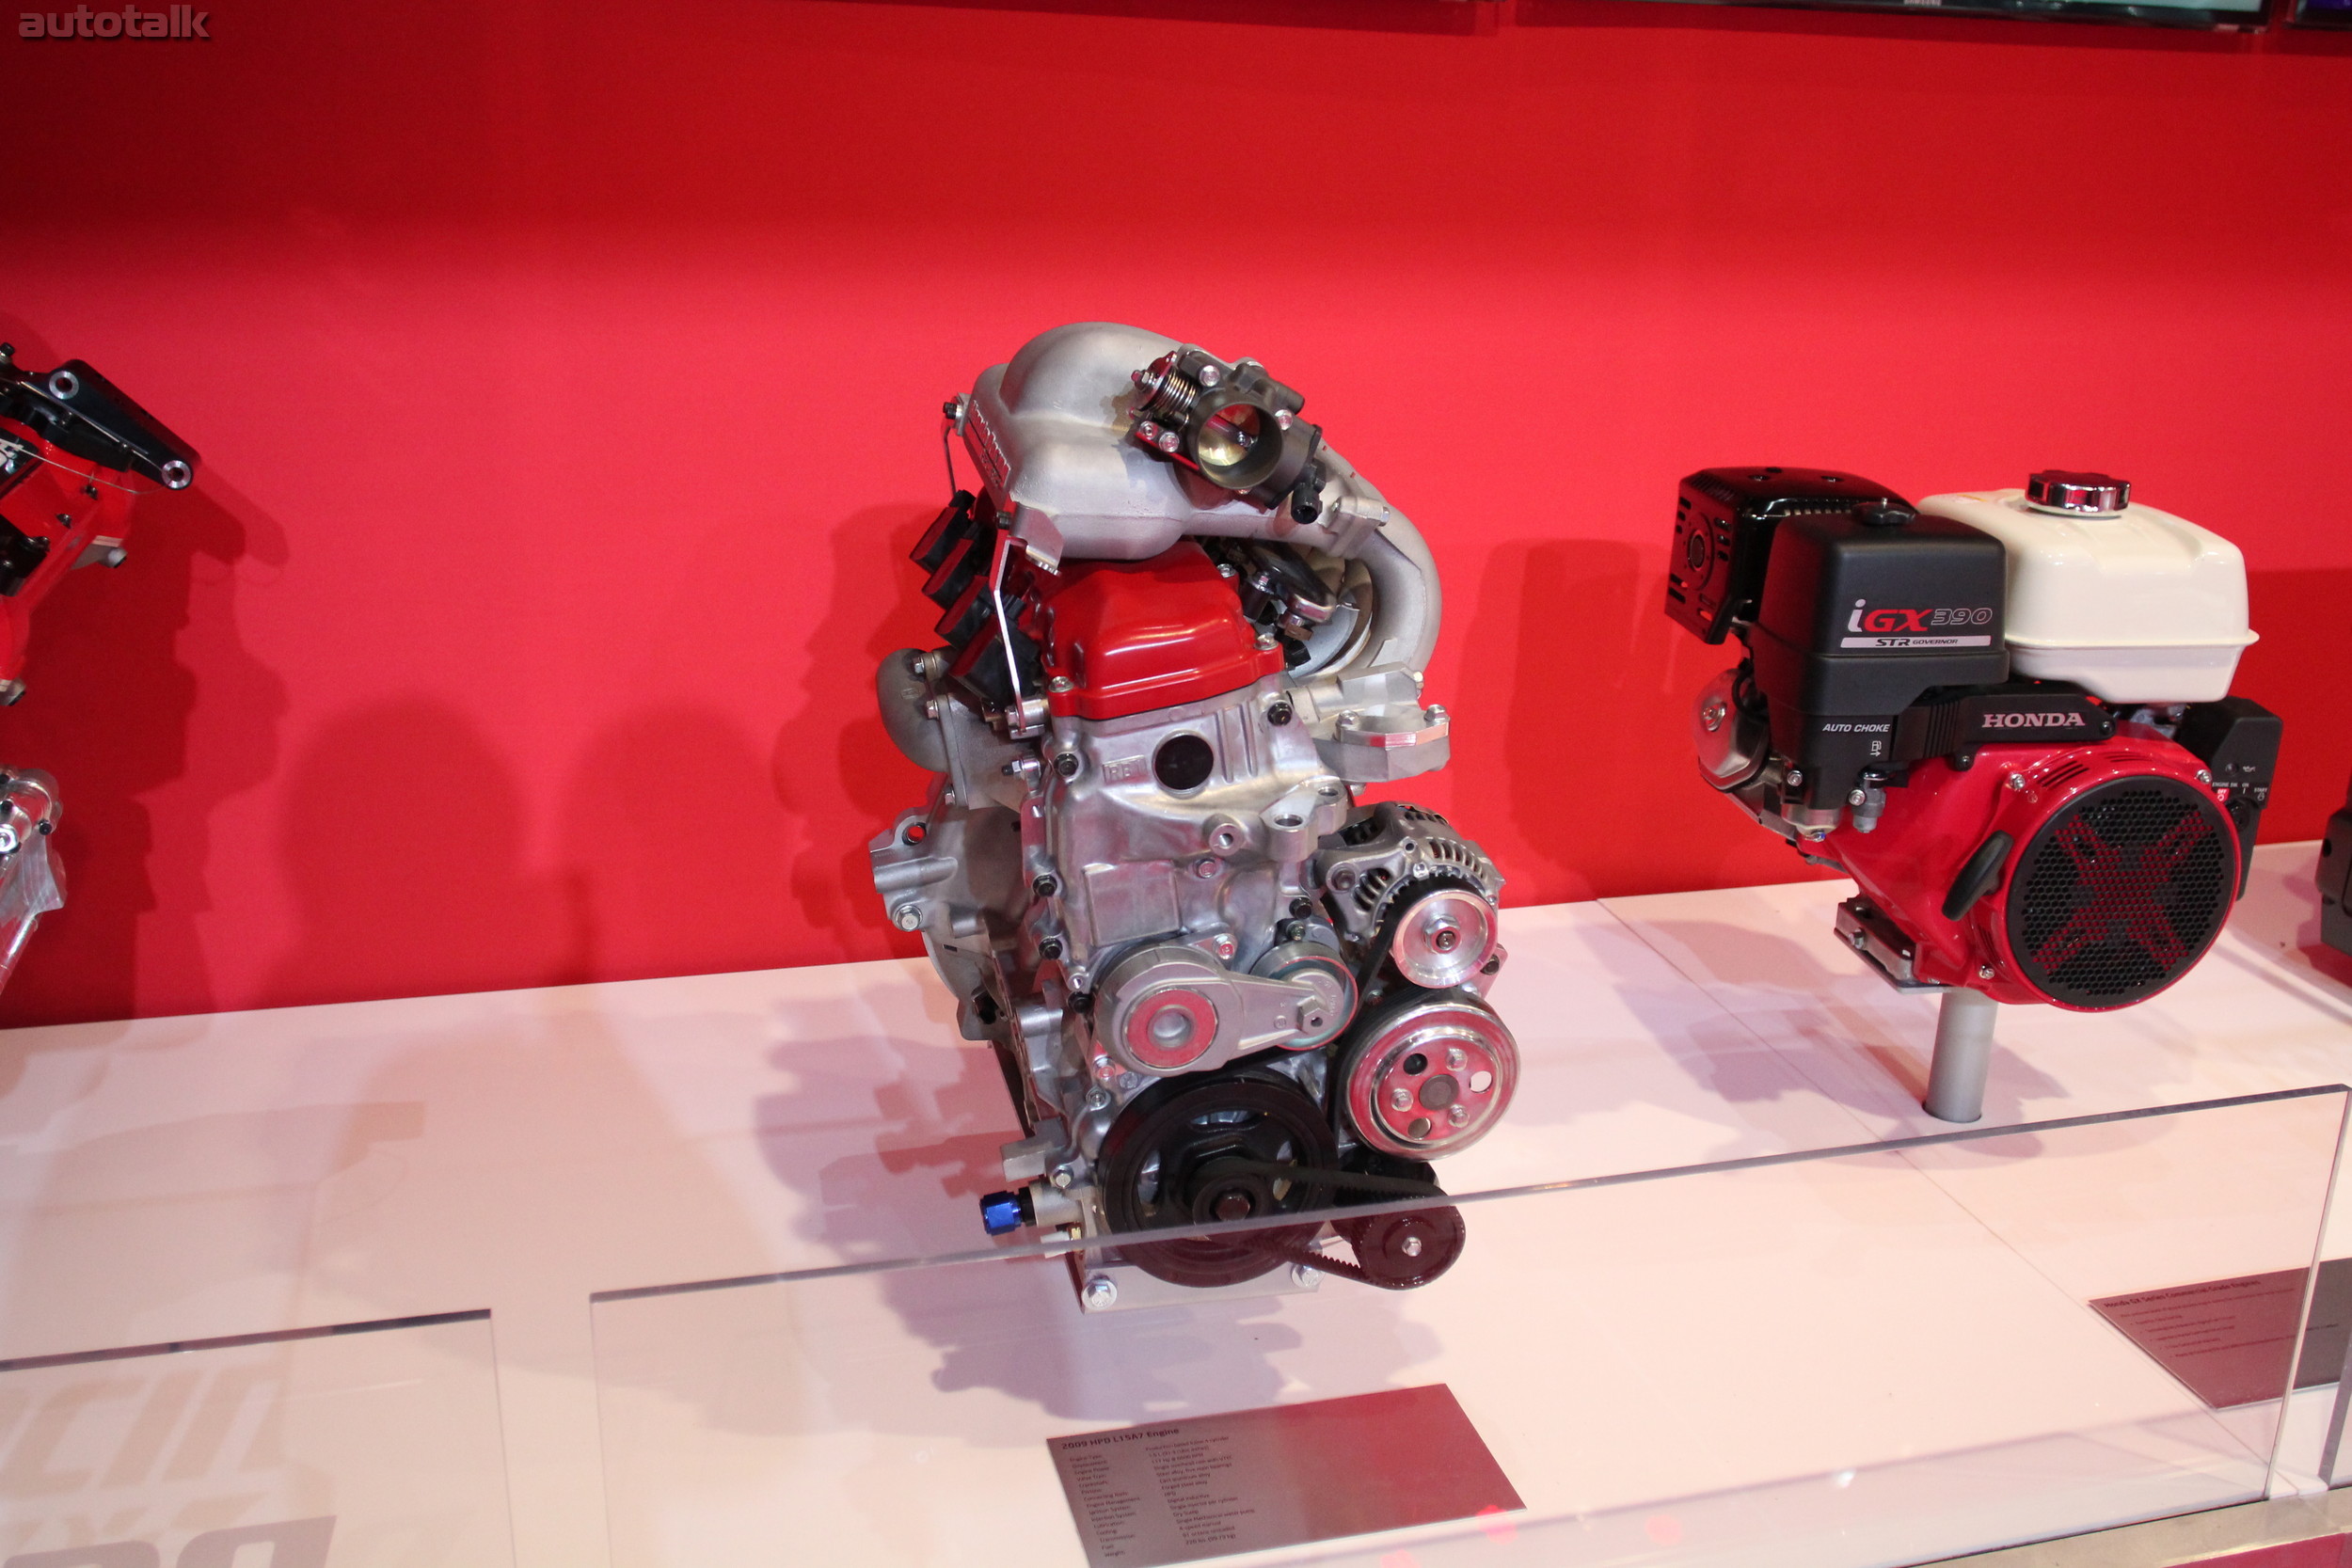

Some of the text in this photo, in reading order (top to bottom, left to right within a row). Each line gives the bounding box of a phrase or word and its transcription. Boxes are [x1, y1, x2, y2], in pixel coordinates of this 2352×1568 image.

[1875, 638, 1911, 647] STR
[1981, 712, 2086, 728] HONDA
[1822, 723, 1890, 733] AUTO CHOKE
[1062, 1441, 1087, 1449] 2009
[1113, 1433, 1143, 1443] L15A7
[1147, 1430, 1179, 1438] Engine
